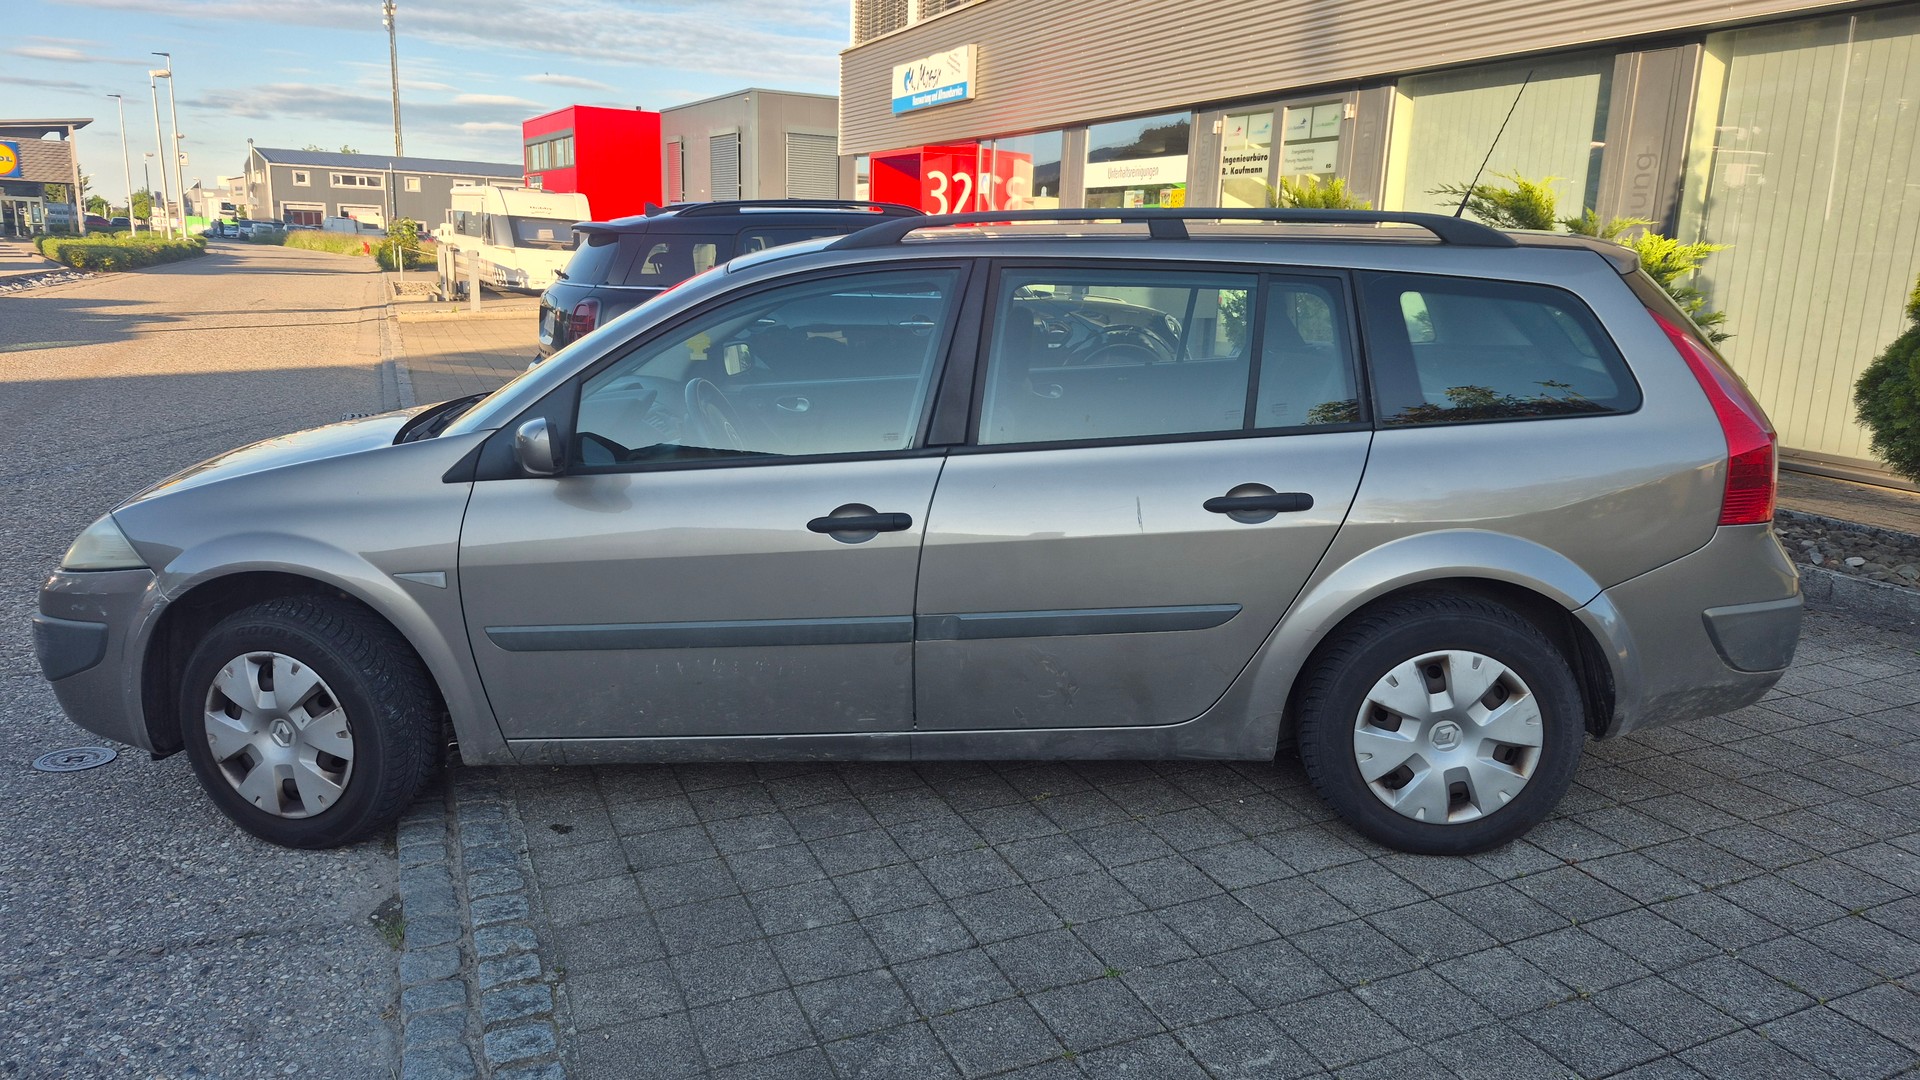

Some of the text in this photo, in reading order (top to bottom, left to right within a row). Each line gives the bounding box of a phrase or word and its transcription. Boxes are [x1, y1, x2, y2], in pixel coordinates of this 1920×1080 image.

[1222, 153, 1268, 166] Ingenieurbüro
[1107, 165, 1159, 180] Unterhaltsreinigungen
[1221, 166, 1263, 175] R. Kaufmann
[926, 170, 972, 216] 32
